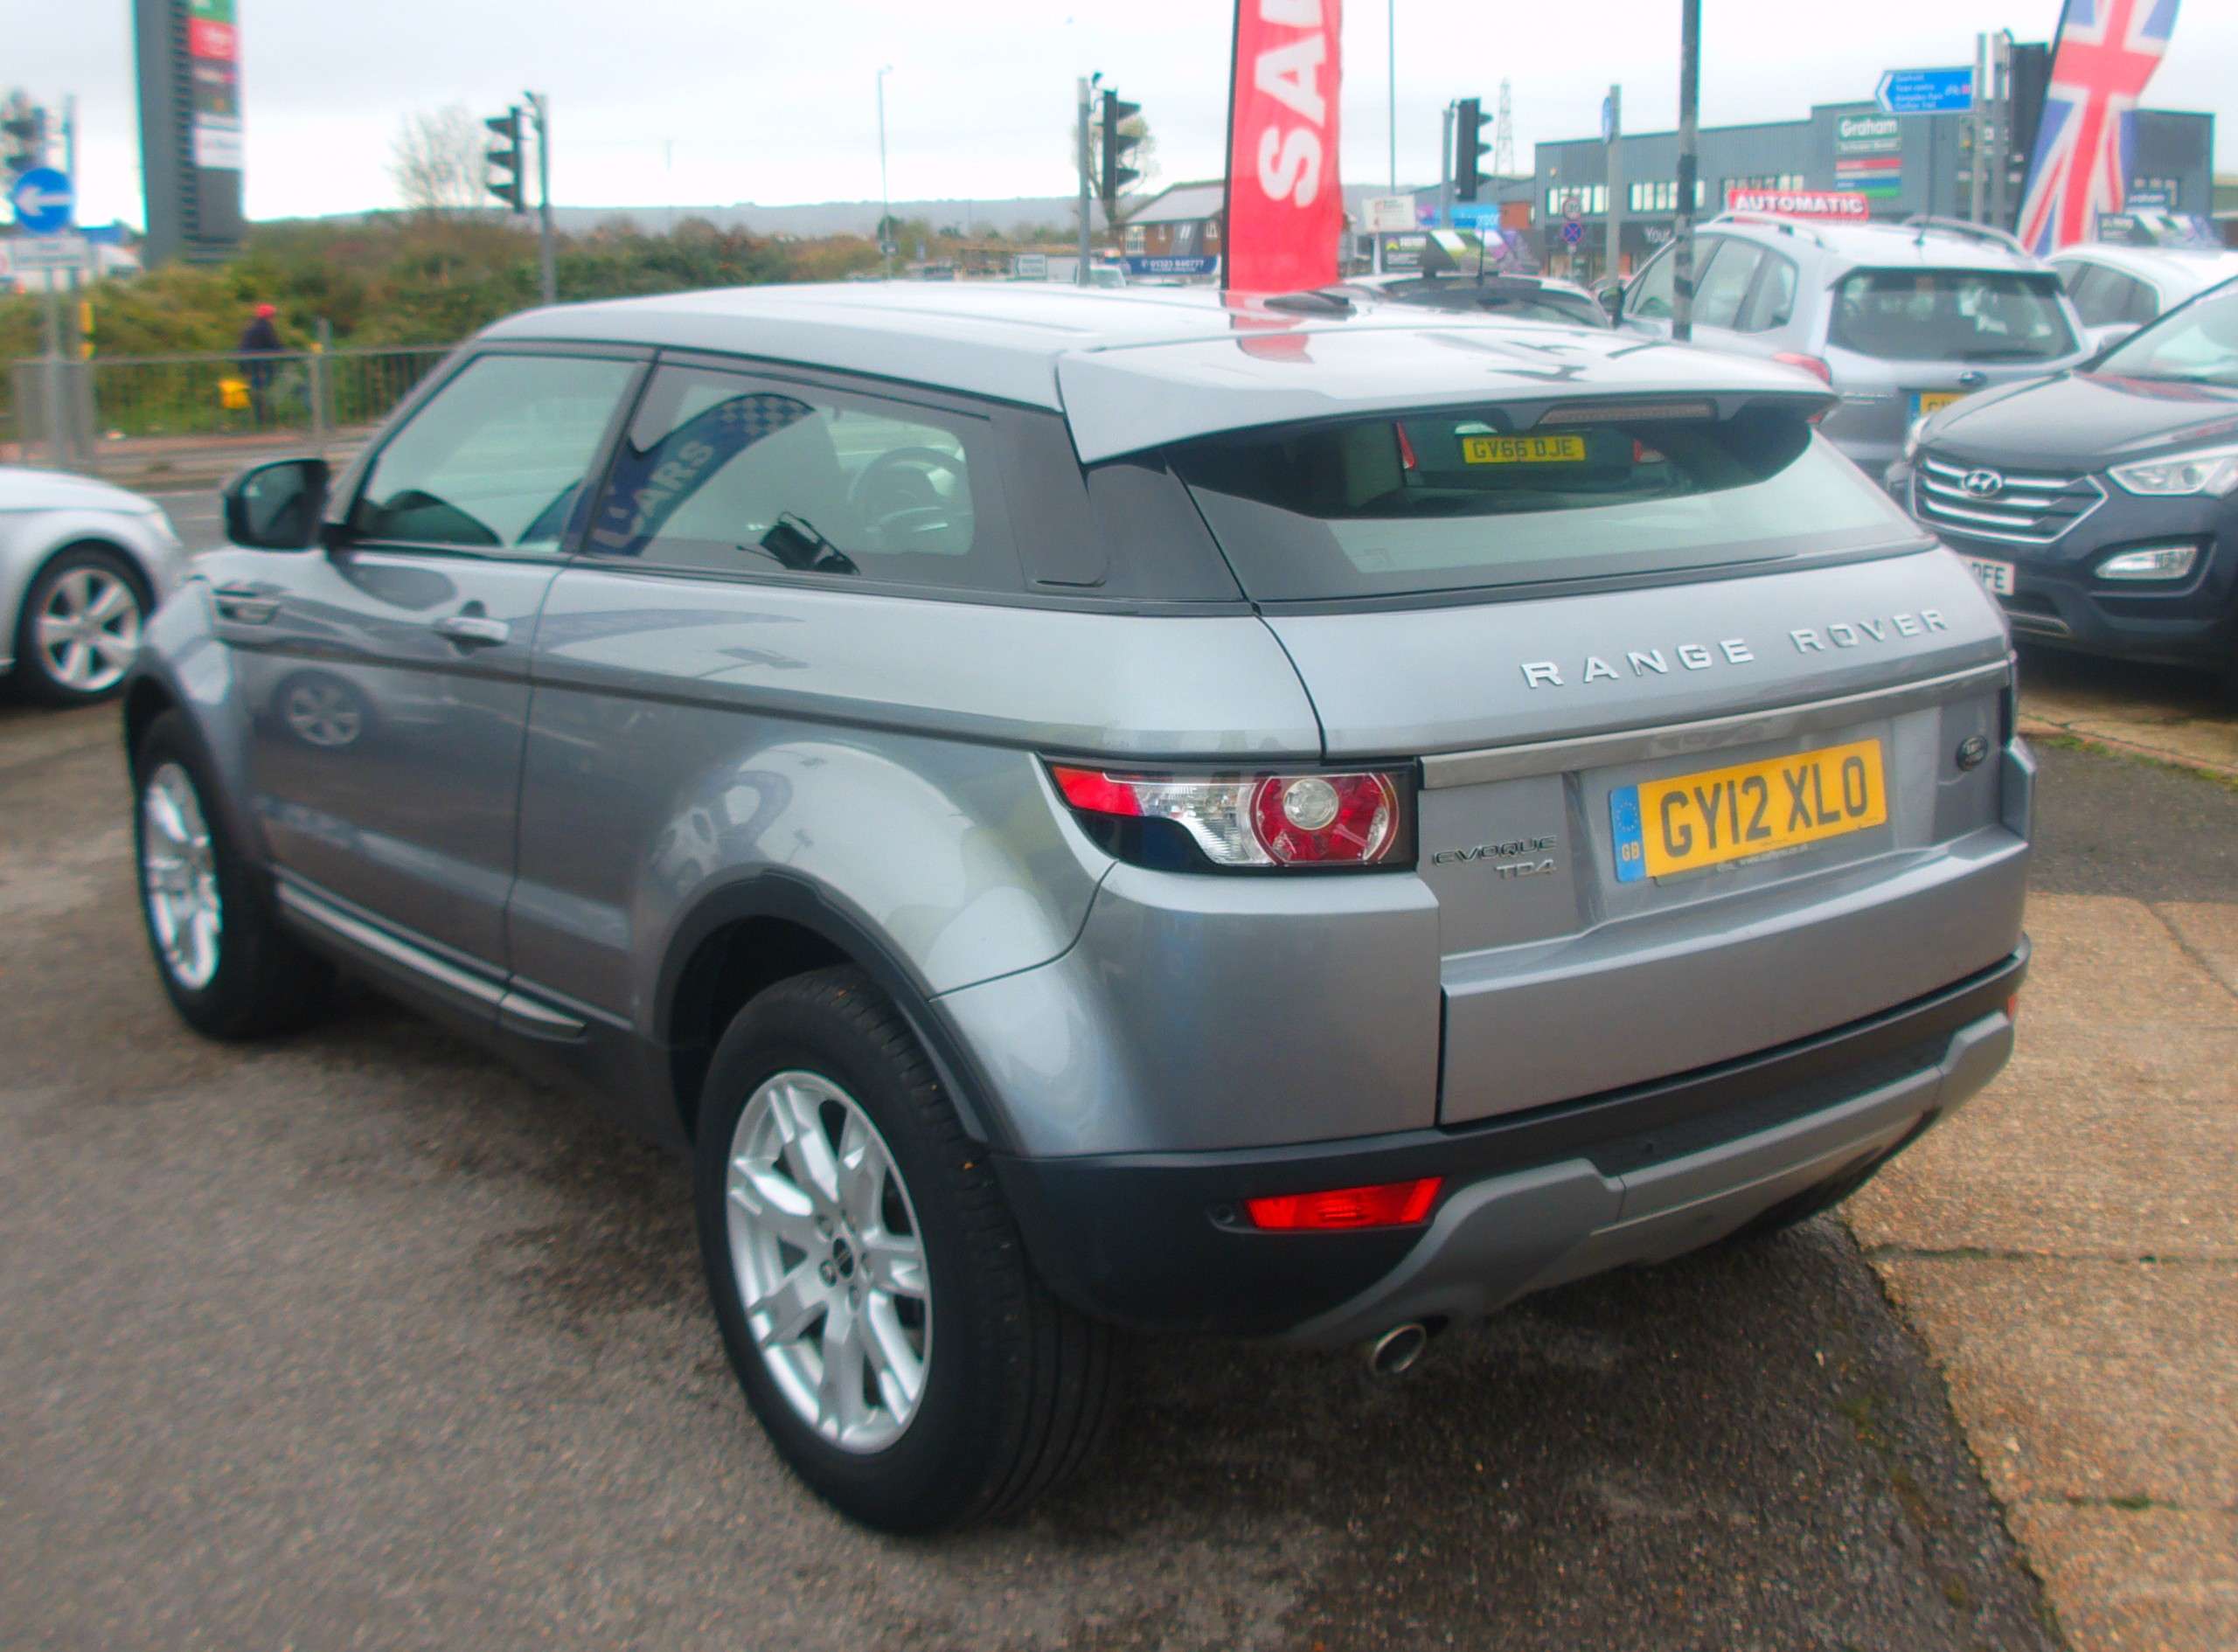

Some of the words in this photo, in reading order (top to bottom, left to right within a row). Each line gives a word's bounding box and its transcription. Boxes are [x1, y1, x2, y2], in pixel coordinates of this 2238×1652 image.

[1840, 119, 1897, 137] Graham
[1735, 193, 1865, 213] AUTOMATIC
[1519, 637, 1755, 689] RANGE
[1790, 608, 1950, 654] ROVER
[1659, 774, 1772, 858] GY12
[1782, 755, 1868, 833] XLO
[1432, 834, 1558, 866] EVOQUE
[1621, 843, 1641, 861] GB
[1494, 857, 1558, 879] TD4
